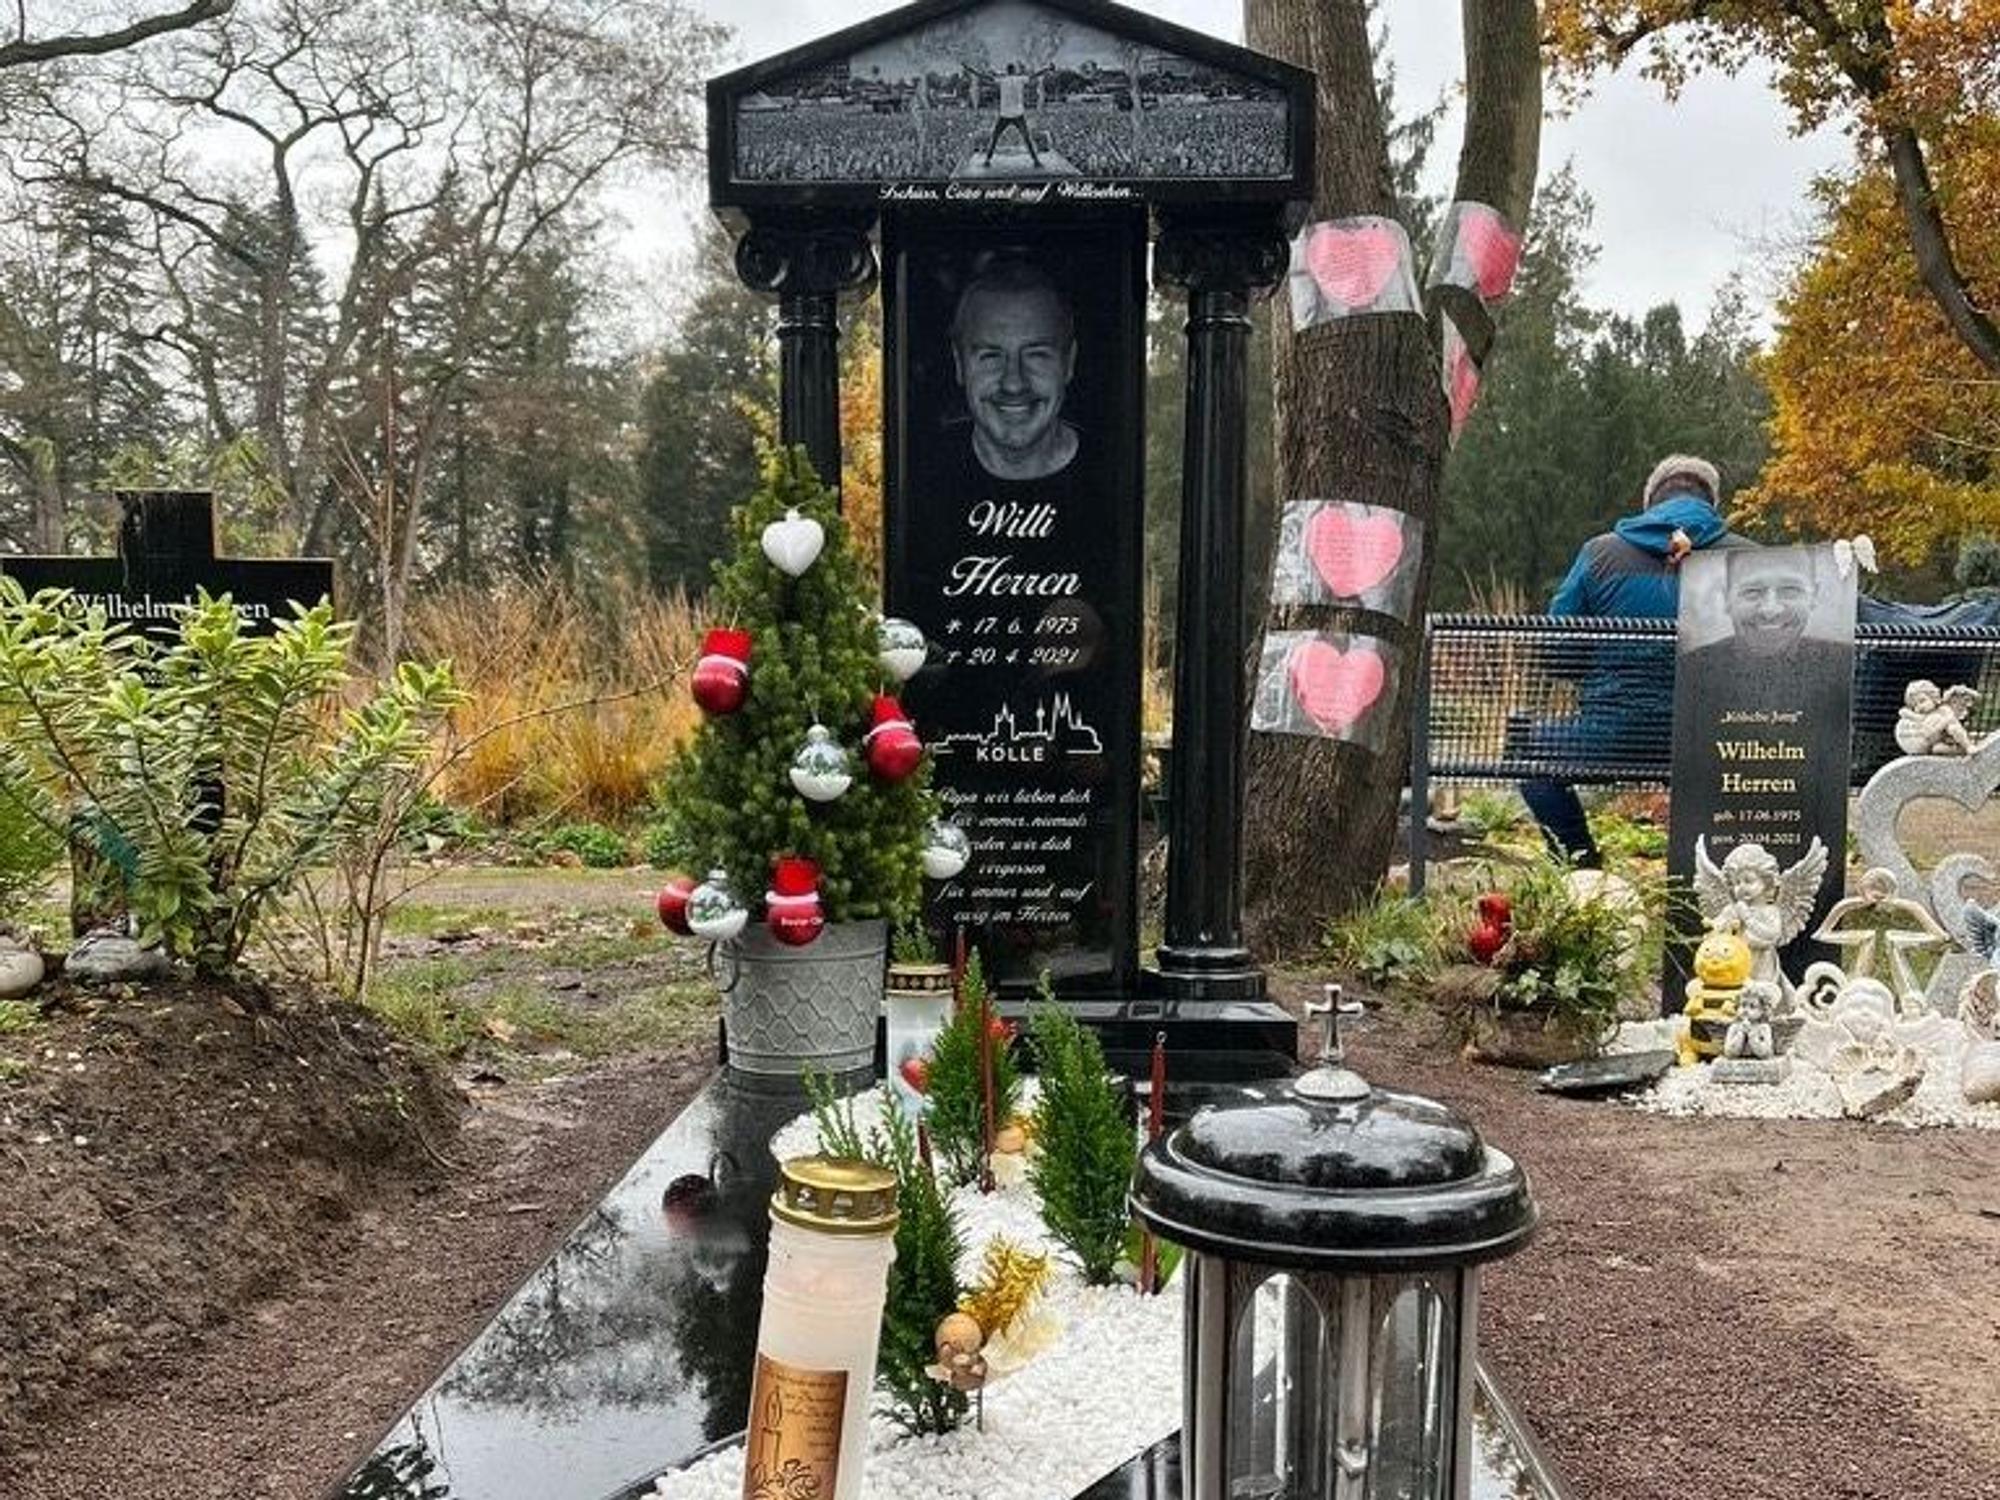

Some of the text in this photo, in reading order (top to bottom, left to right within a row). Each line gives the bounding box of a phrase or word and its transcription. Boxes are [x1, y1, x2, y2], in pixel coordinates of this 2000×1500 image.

[1020, 182, 1051, 204] auf
[968, 500, 1057, 538] Willi
[942, 555, 1082, 596] Herren
[1033, 616, 1080, 635] 1975
[1028, 646, 1080, 665] 2021
[976, 742, 1044, 762] KÖLLE
[1716, 741, 1805, 760] Wilhelm
[1721, 773, 1797, 793] Herren
[1060, 881, 1095, 904] auf
